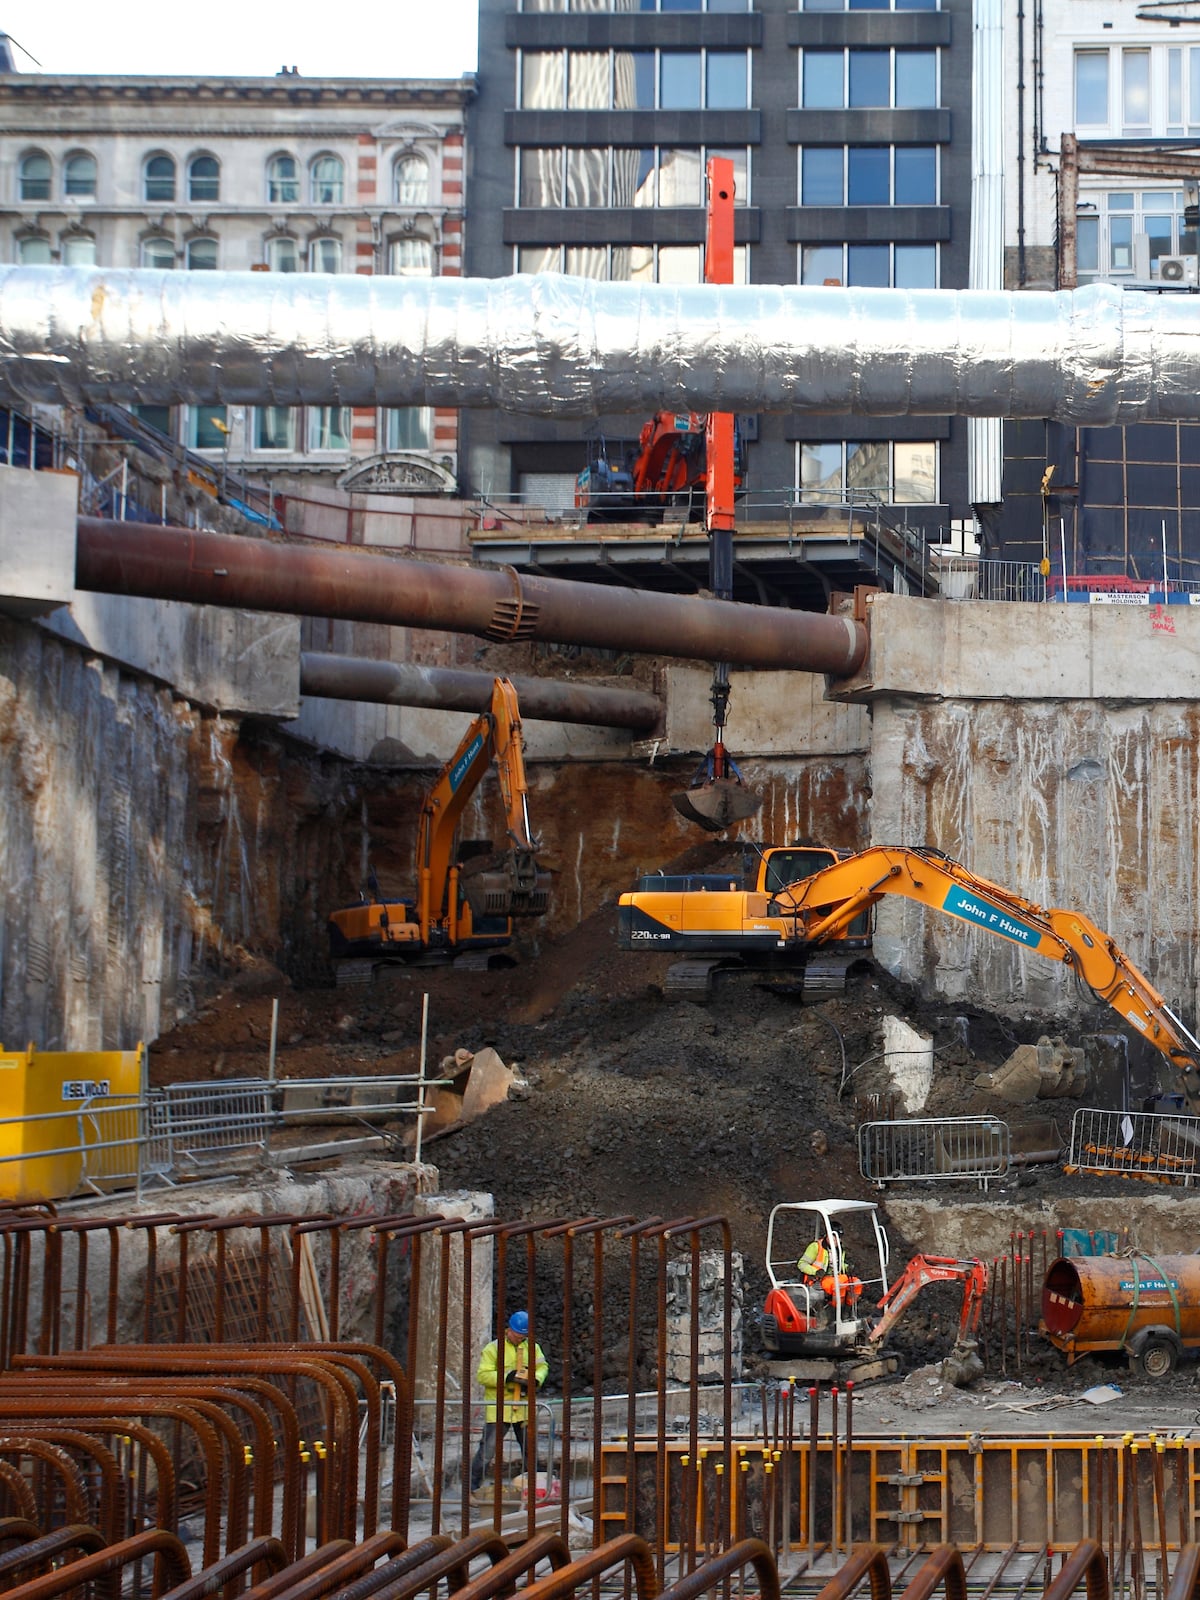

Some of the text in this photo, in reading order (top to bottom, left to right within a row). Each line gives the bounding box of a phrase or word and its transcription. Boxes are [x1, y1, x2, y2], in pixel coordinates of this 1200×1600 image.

[957, 899, 1029, 940] John F Hunt
